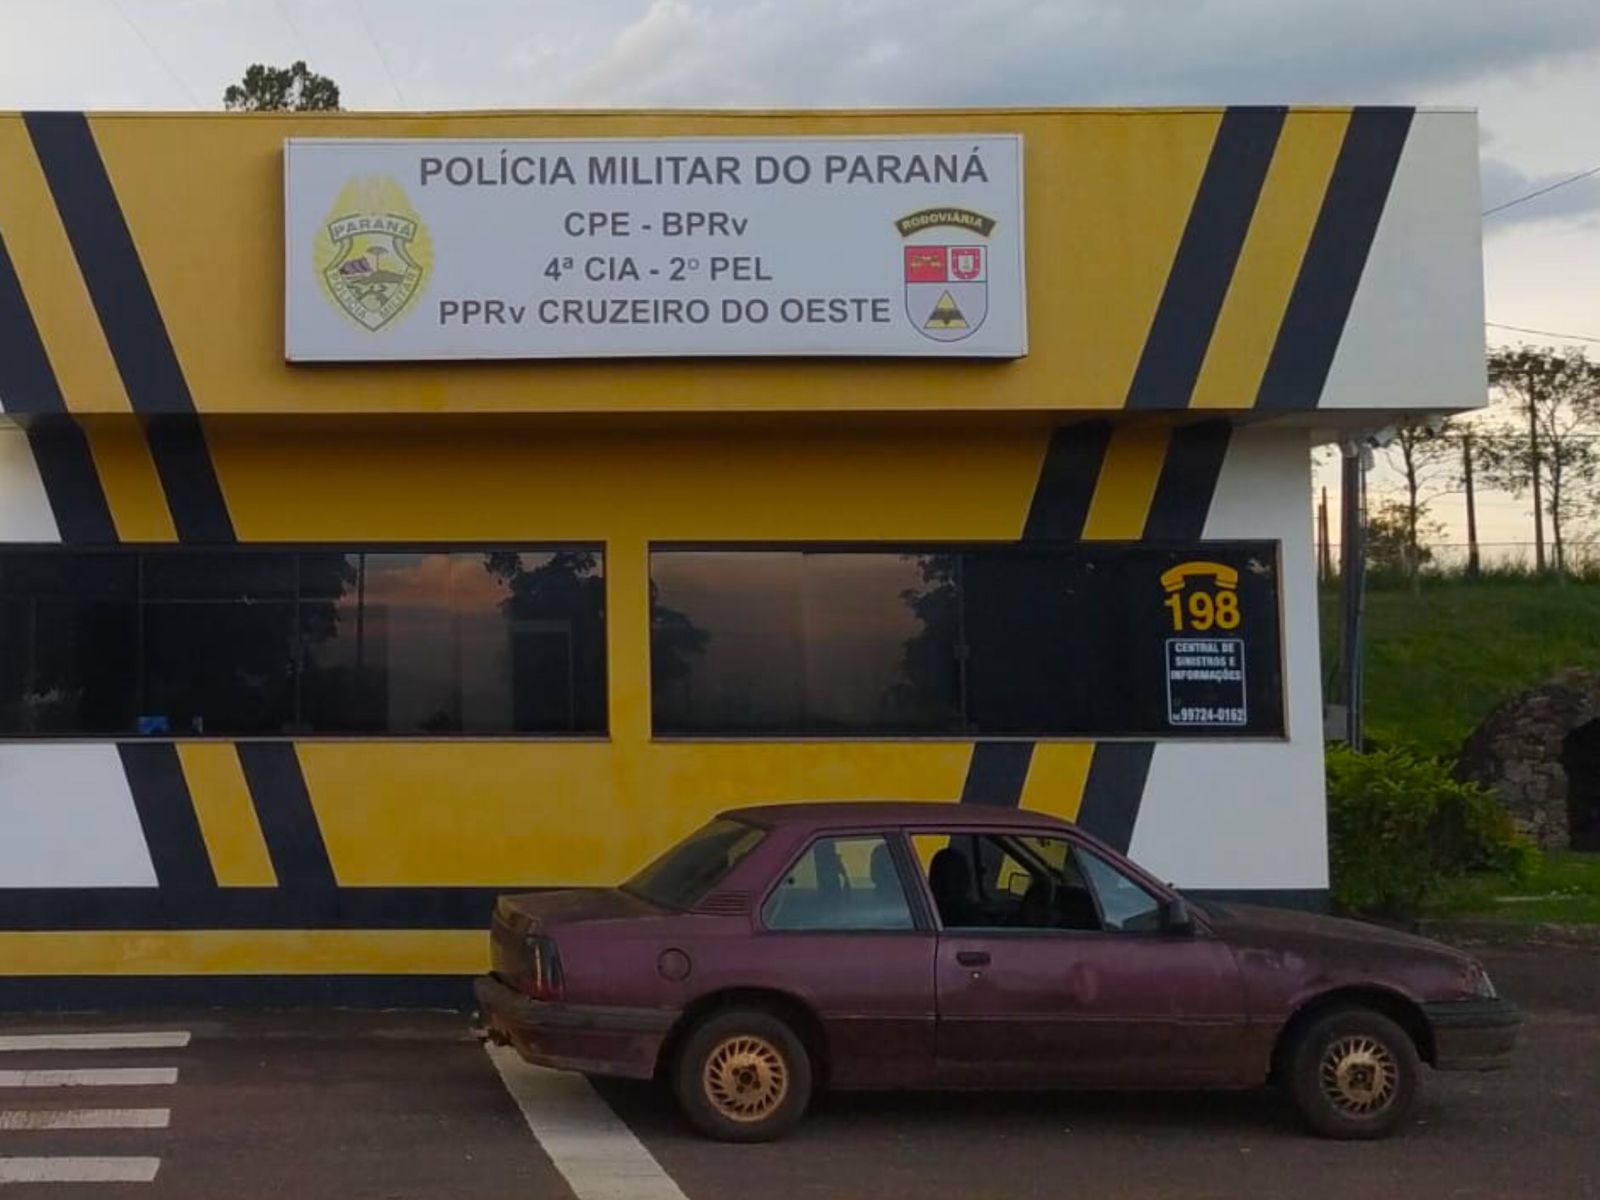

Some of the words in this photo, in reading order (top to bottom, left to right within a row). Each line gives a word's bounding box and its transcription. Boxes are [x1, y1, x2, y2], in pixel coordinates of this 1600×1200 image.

[421, 149, 576, 187] POLÍCIA
[588, 156, 741, 186] MILITAR
[755, 155, 811, 185] DO
[825, 146, 989, 184] PARANÁ
[564, 211, 630, 237] CPE
[662, 211, 748, 237] BPRv
[584, 256, 641, 282] CIA
[711, 256, 773, 281] PEL
[439, 299, 526, 325] PPRv
[538, 298, 710, 325] CRUZEIRO
[721, 298, 769, 324] DO
[780, 297, 891, 324] OESTE
[1164, 590, 1241, 631] 198
[1174, 642, 1219, 653] CENTRAL
[1221, 642, 1235, 653] DE
